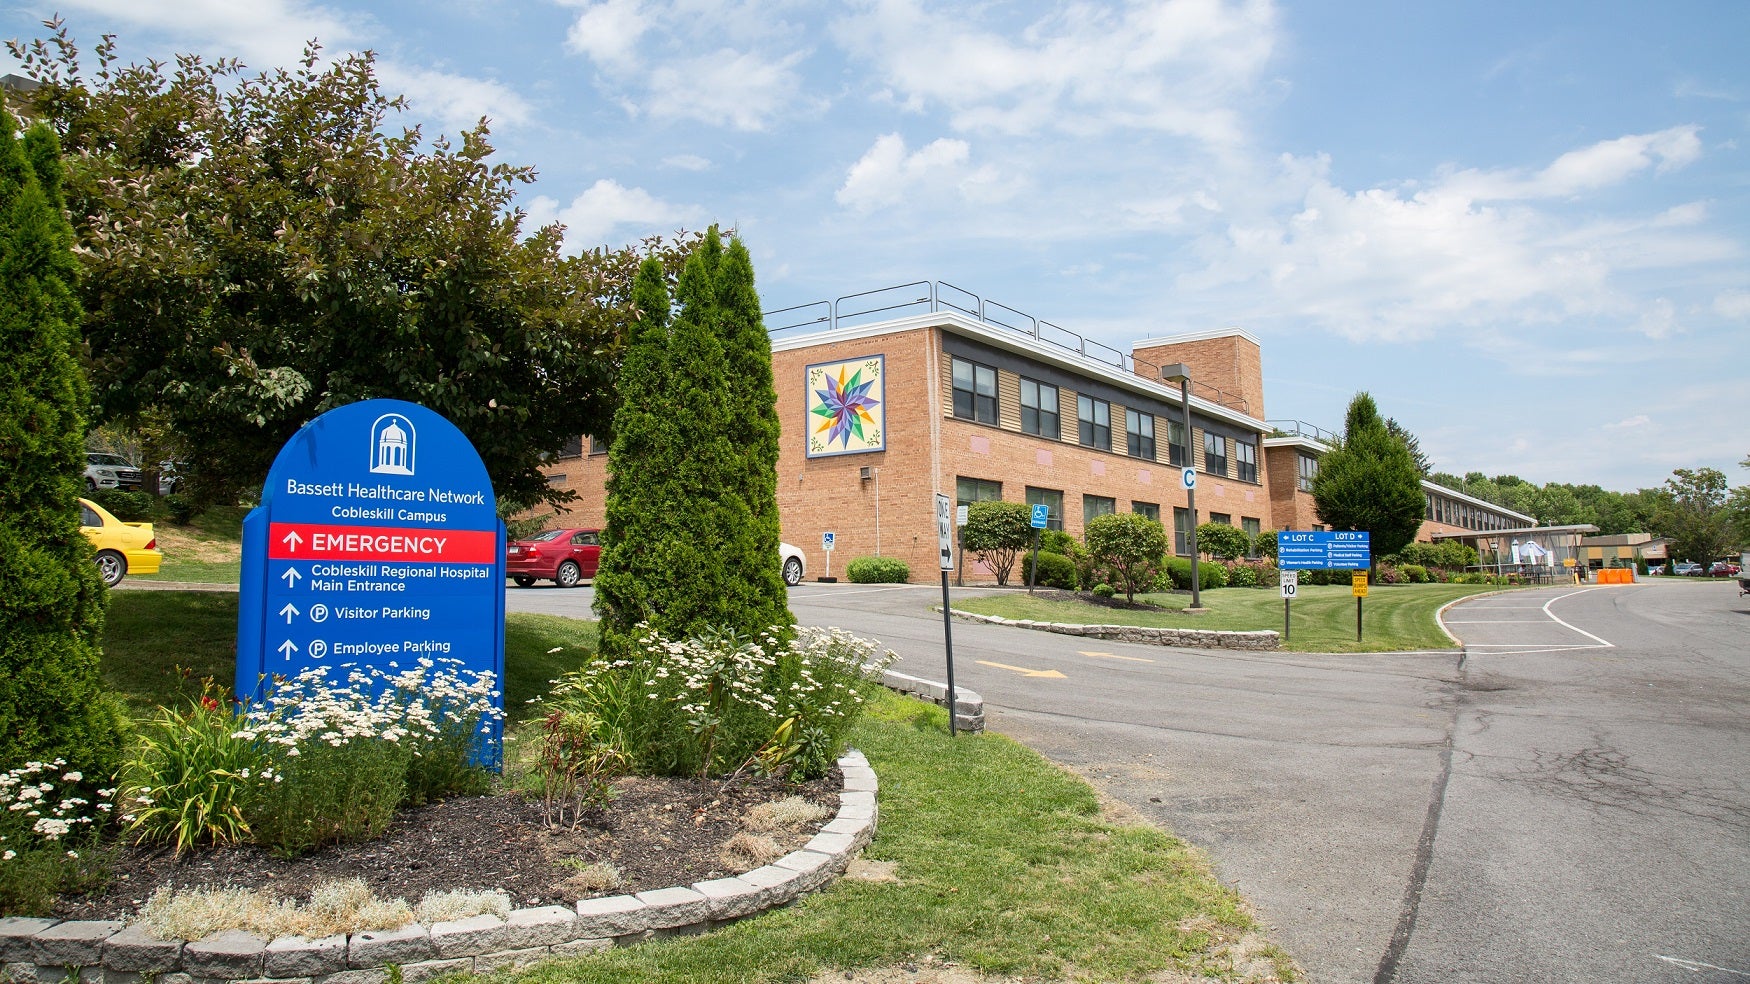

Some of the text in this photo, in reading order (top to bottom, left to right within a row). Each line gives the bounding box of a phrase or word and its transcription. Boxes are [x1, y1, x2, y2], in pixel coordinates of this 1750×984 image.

[1184, 469, 1195, 487] C
[287, 479, 485, 505] Bassett Healthcare Network
[331, 506, 447, 524] Cobleskill Campus
[938, 500, 949, 519] ONE
[940, 522, 950, 540] WAY
[1292, 534, 1314, 542] LOT C
[1335, 532, 1349, 540] LOT
[312, 533, 448, 554] EMERGENCY
[311, 564, 489, 580] Cobleskill Regional Hospital
[311, 579, 406, 592] Main Entrance
[1282, 584, 1295, 595] 10
[335, 607, 379, 619] Visitor
[382, 607, 431, 620] Parking
[333, 642, 400, 655] Employee
[403, 640, 451, 653] Parking
